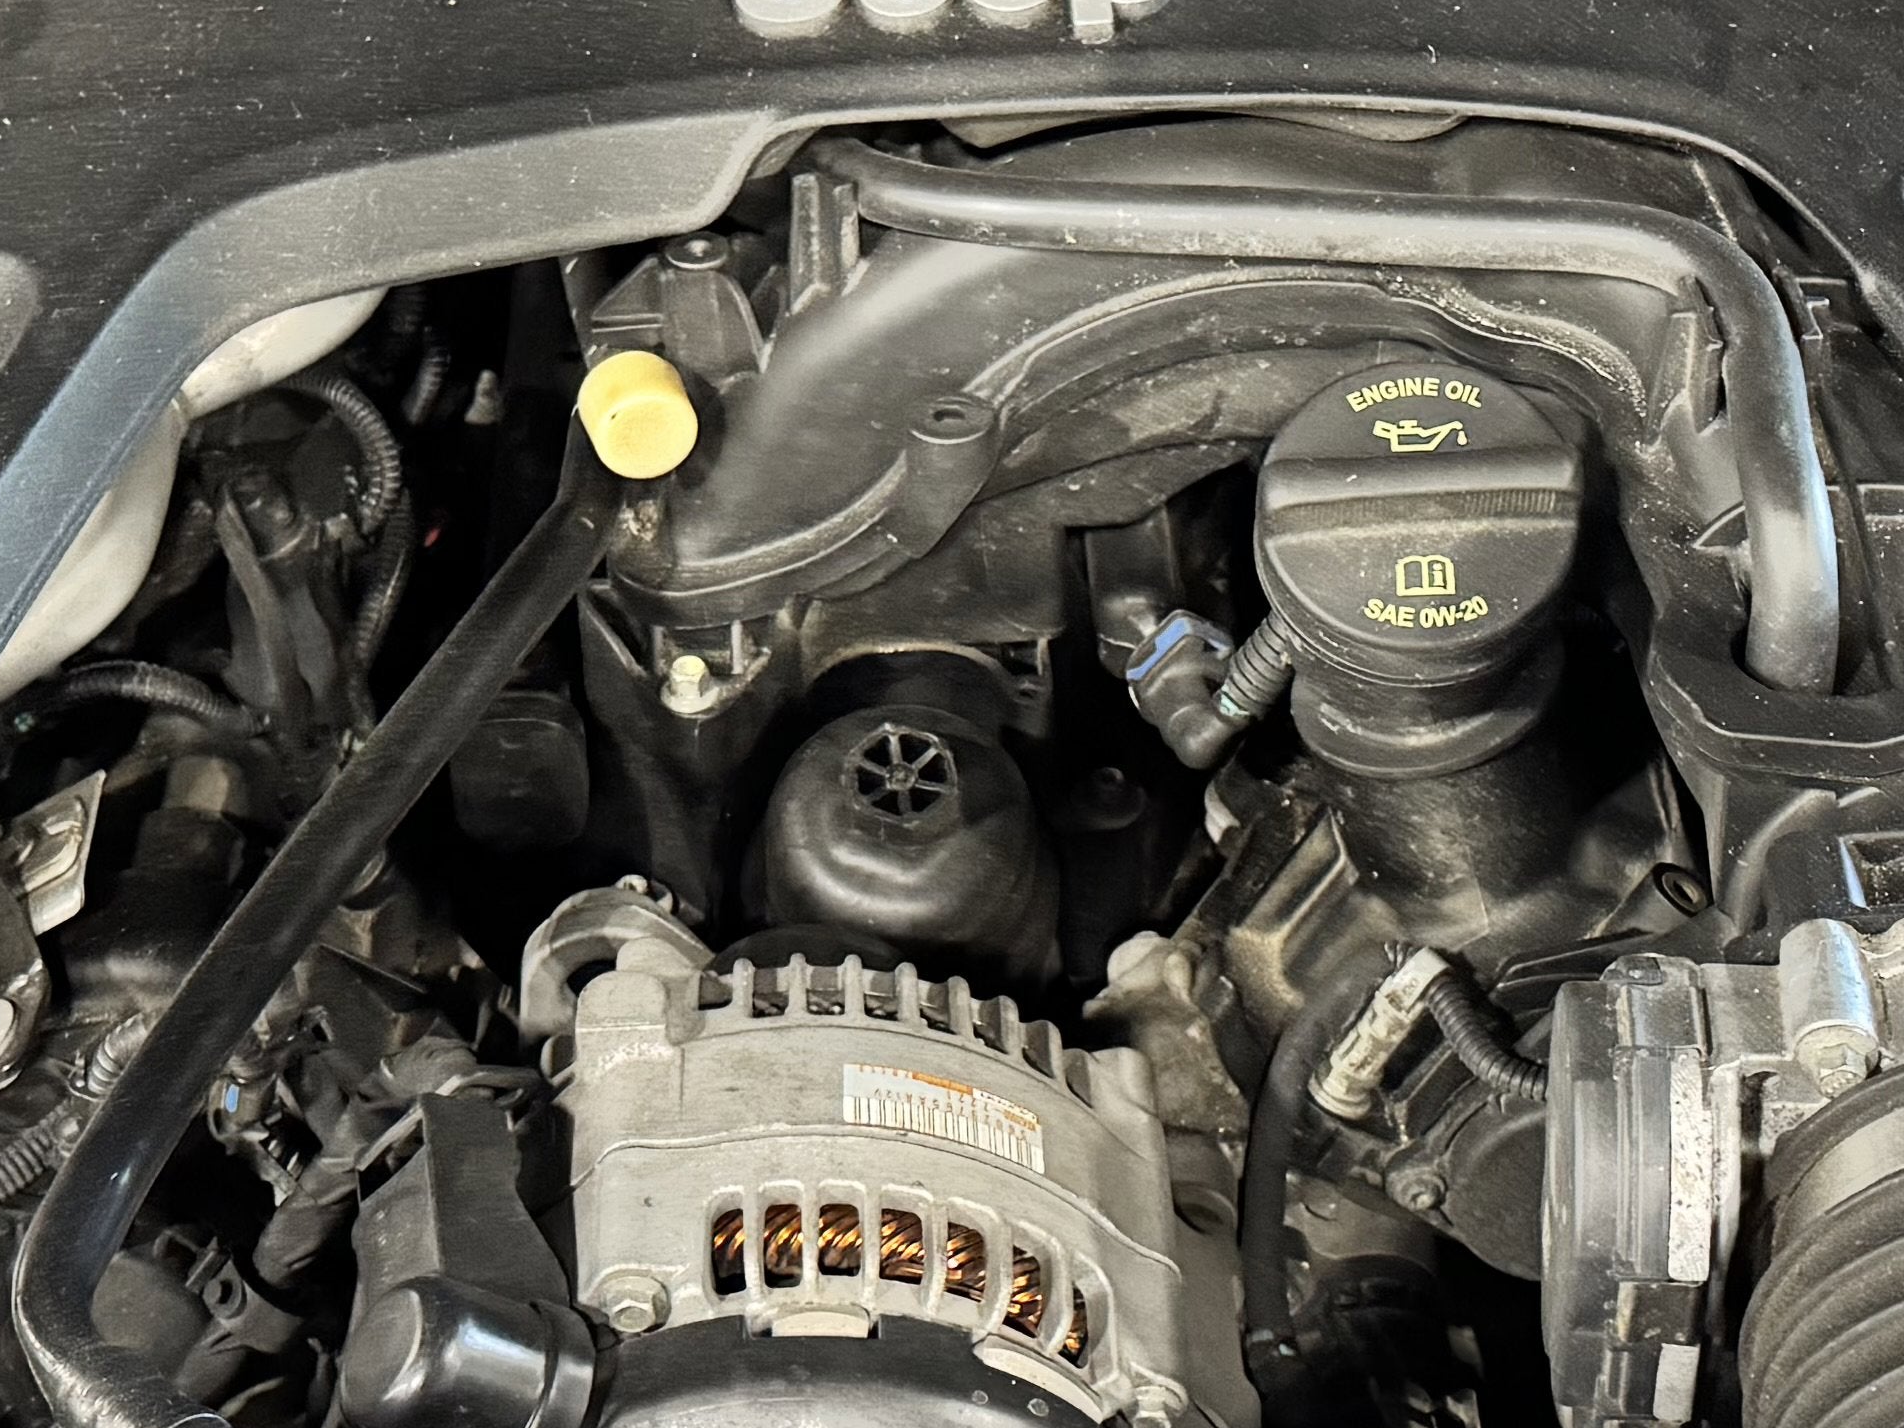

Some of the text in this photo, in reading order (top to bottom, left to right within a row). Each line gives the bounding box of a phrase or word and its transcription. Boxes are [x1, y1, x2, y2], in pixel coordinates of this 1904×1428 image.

[1345, 375, 1484, 414] ENGINE OIL
[1363, 594, 1490, 631] SAE 0W-20
